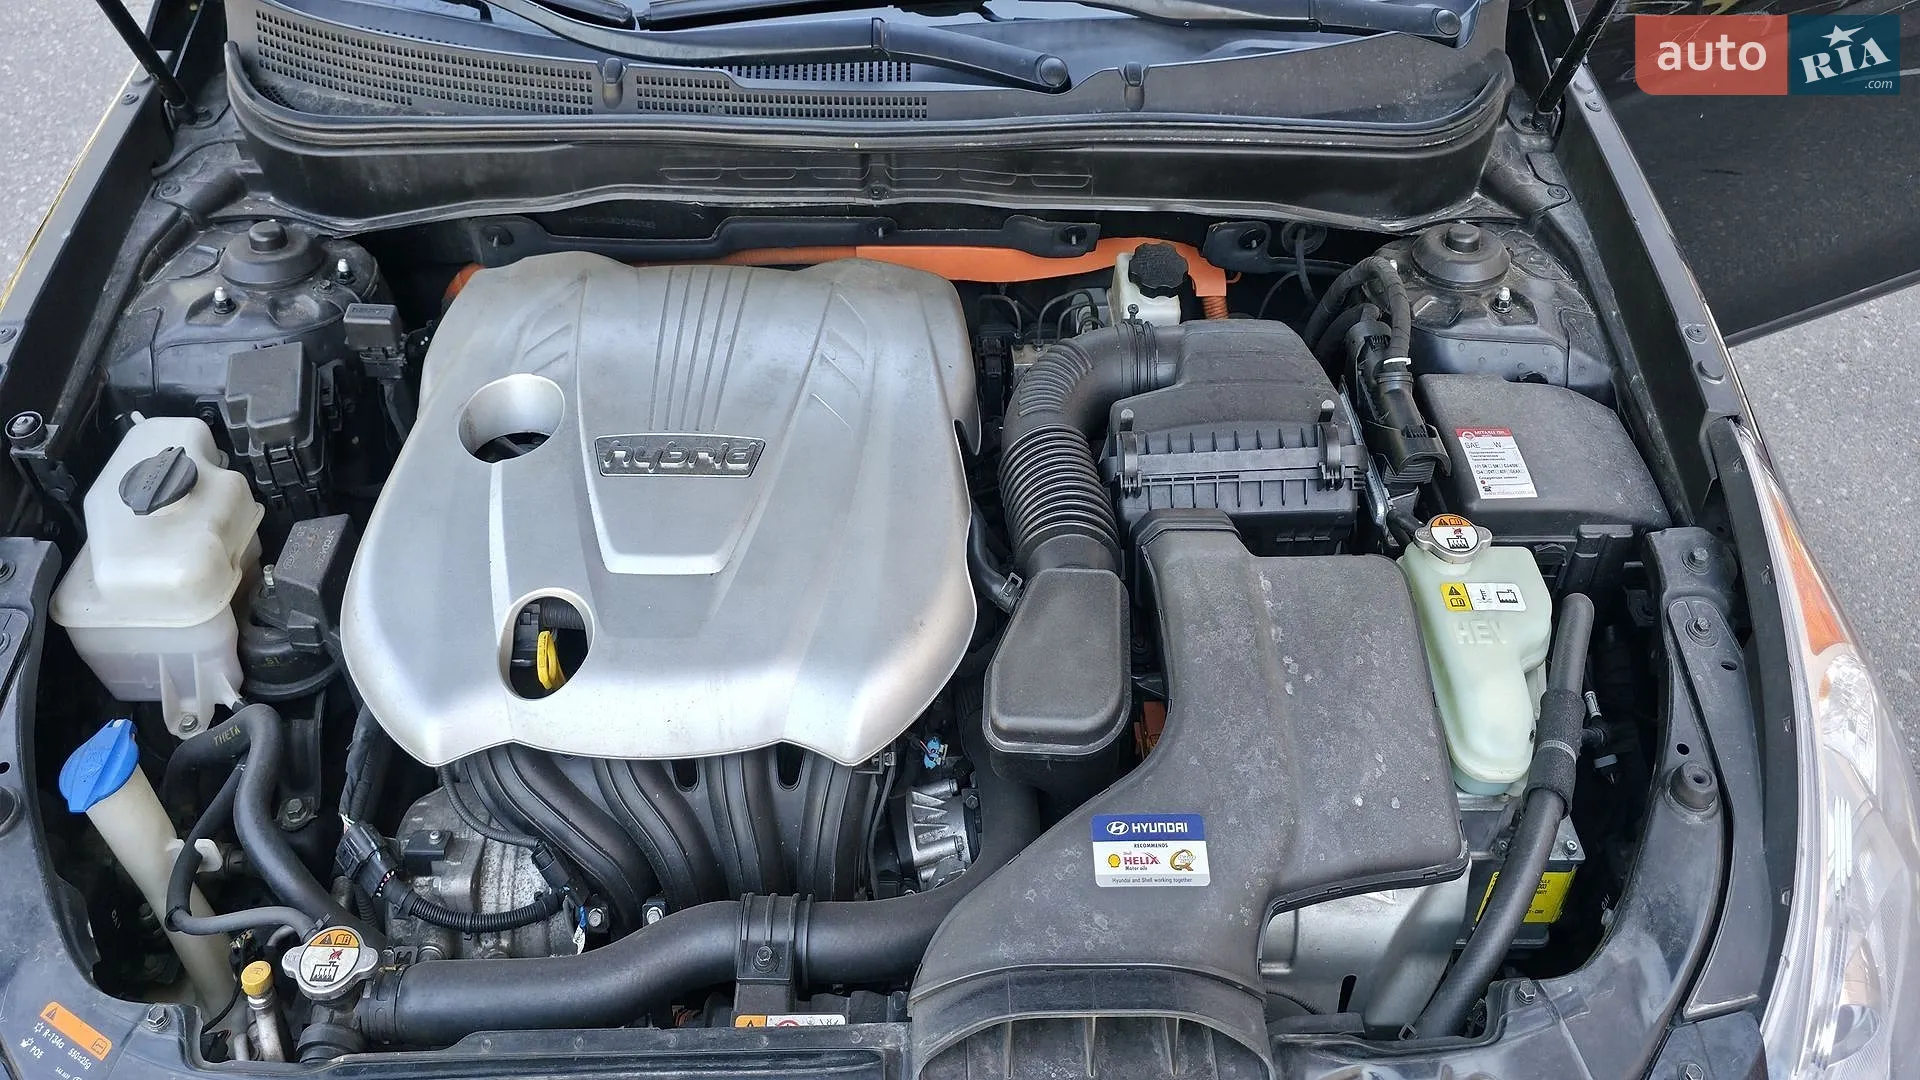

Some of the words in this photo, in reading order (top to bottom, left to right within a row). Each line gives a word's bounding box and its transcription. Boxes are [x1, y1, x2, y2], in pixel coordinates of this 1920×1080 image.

[1464, 441, 1481, 449] SAE
[603, 440, 758, 473] hybrid
[1132, 822, 1188, 833] HYUNDAI
[1123, 855, 1161, 865] HELIX
